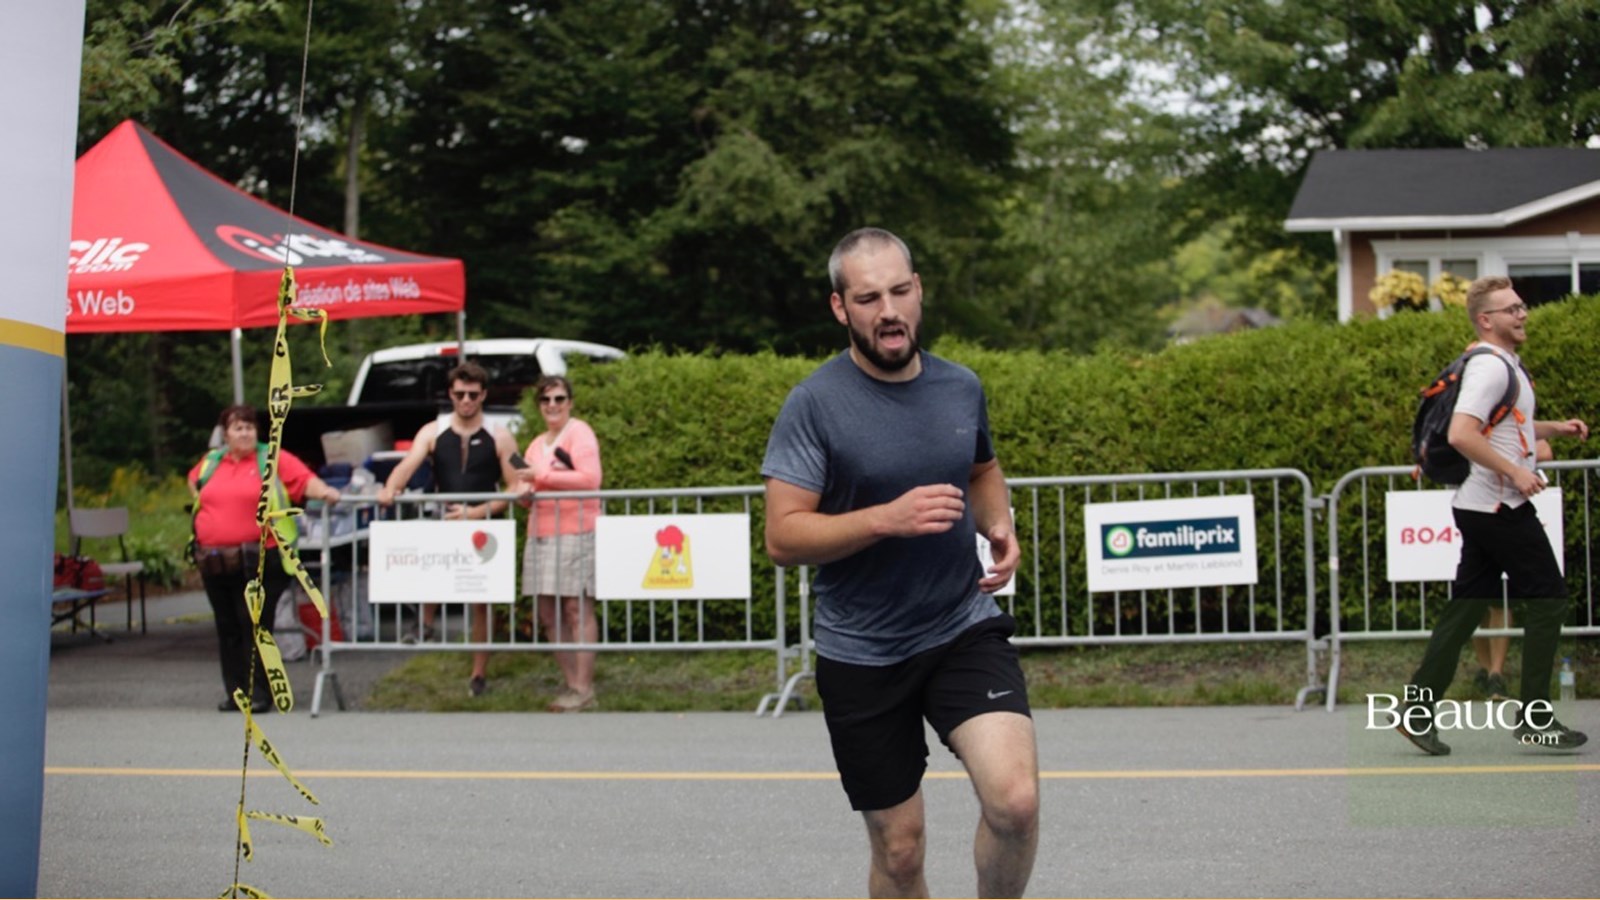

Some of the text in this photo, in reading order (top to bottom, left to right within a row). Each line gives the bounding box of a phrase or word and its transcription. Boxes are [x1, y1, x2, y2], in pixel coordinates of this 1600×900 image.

[77, 290, 135, 316] Web
[344, 279, 362, 304] de
[363, 280, 390, 302] sites
[390, 277, 420, 299] Web
[1136, 524, 1235, 551] familiprix
[1153, 563, 1164, 572] et
[1167, 561, 1198, 571] Martin
